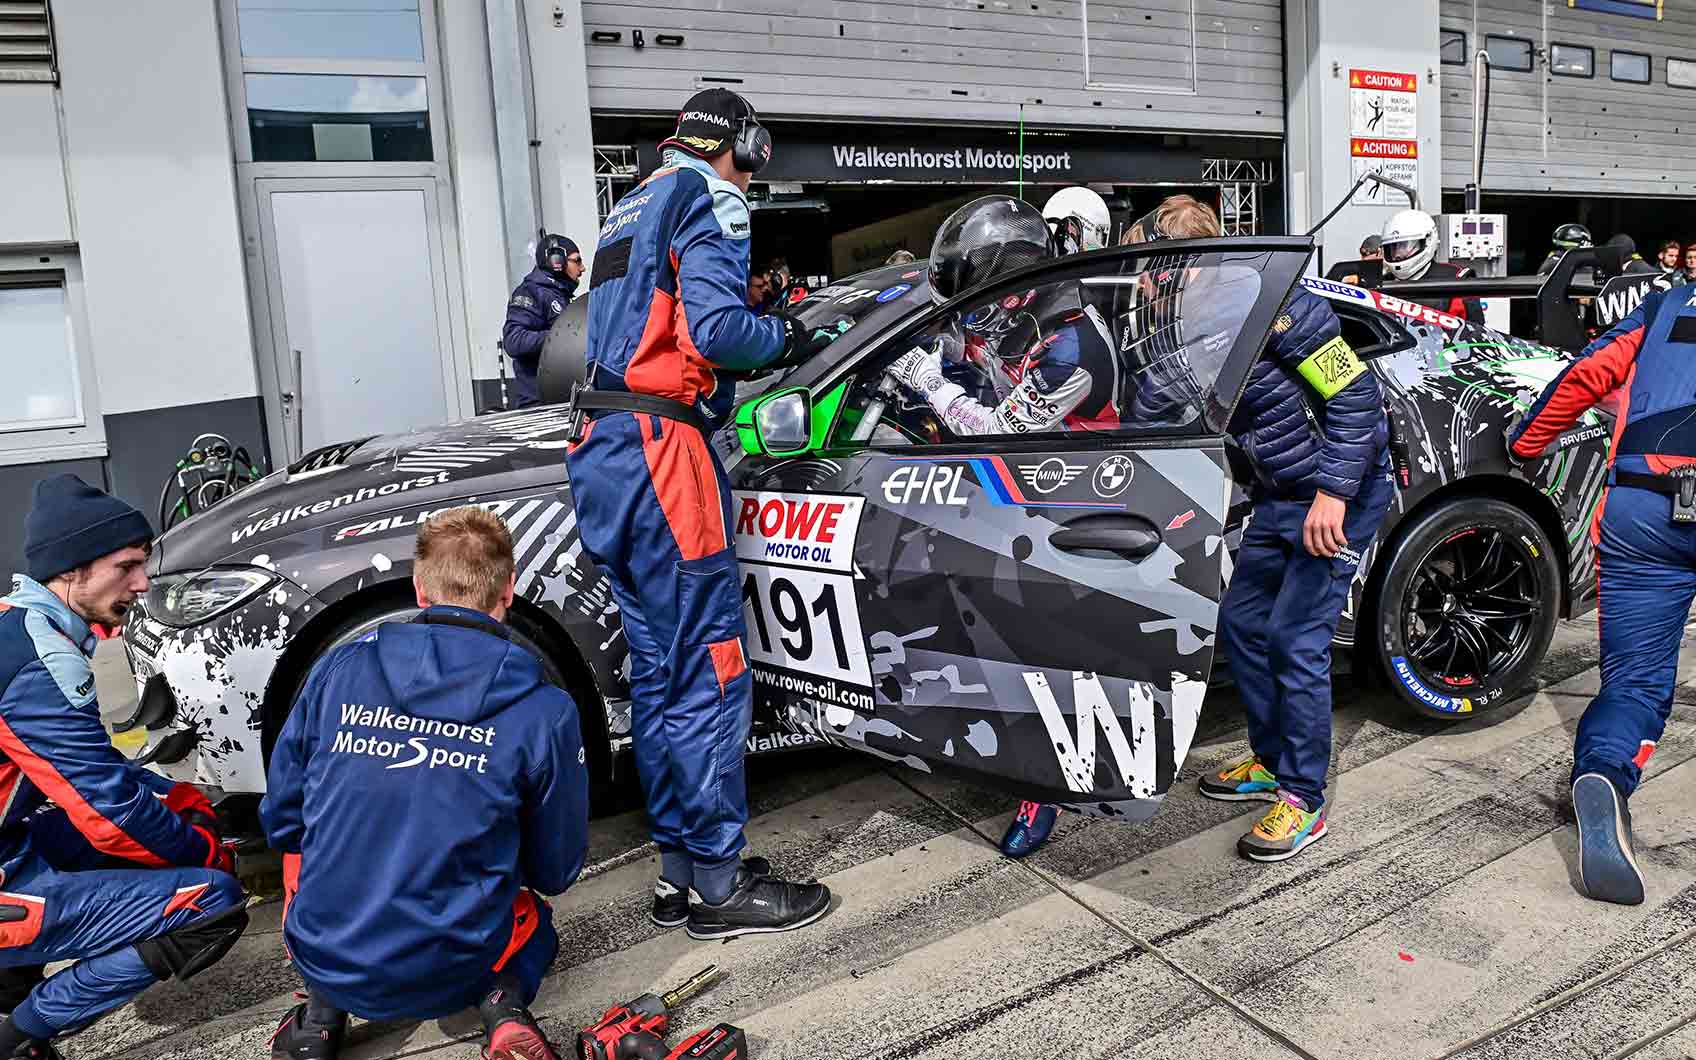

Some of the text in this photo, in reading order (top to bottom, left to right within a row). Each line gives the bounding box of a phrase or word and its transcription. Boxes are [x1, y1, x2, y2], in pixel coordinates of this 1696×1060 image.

[1365, 75, 1402, 87] CAUTION
[833, 145, 1071, 173] Walkenhorst Motorsport
[1363, 142, 1408, 155] ACHTUNG
[1379, 293, 1461, 330] auto
[1560, 427, 1608, 447] RAVENOL
[880, 465, 968, 505] EHRL
[1037, 471, 1062, 481] MINI
[230, 470, 450, 544] Walkenhorst
[735, 497, 845, 543] ROWE
[765, 542, 832, 563] MOTOR OIL
[742, 573, 851, 670] 191
[1397, 662, 1450, 708] MICHELIN
[340, 703, 497, 747] Walkenhorst
[331, 731, 488, 774] MotorSport
